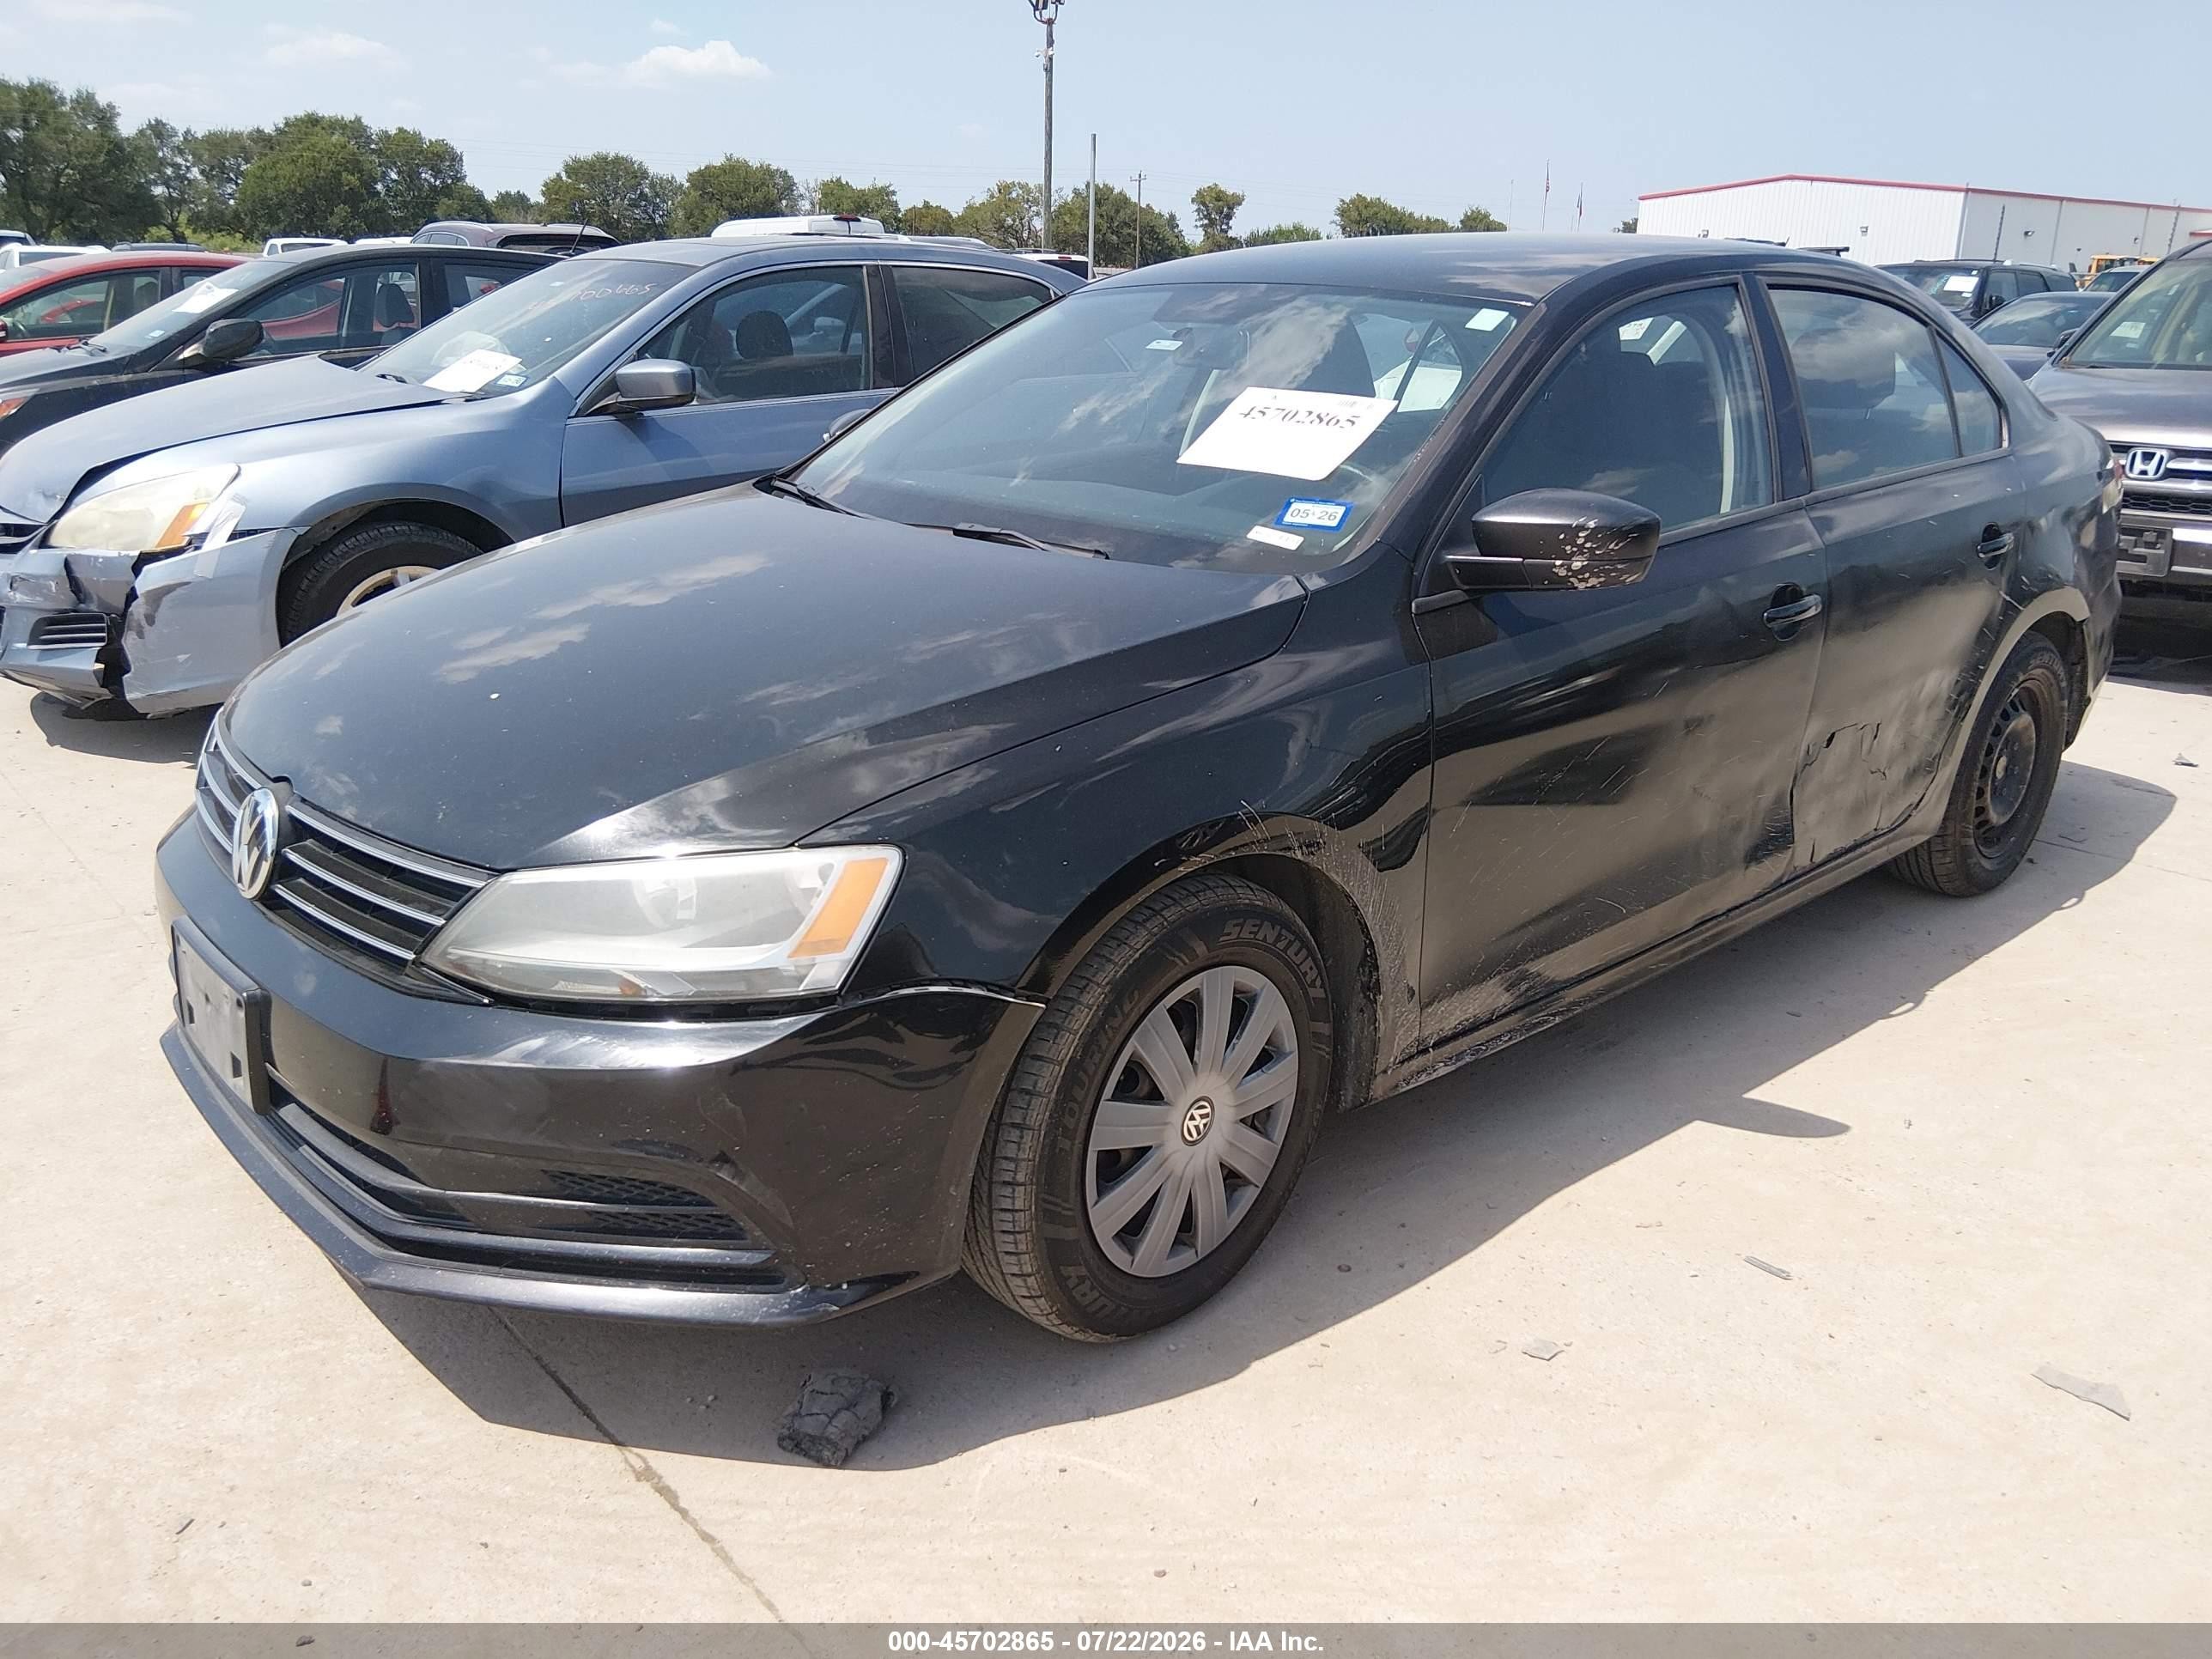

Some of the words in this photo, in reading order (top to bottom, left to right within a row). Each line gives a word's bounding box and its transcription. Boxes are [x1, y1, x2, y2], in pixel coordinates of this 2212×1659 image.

[1239, 406, 1361, 428] 45702865
[1291, 508, 1311, 519] 05
[1317, 510, 1339, 521] 26
[1218, 918, 1327, 999] SENTURY
